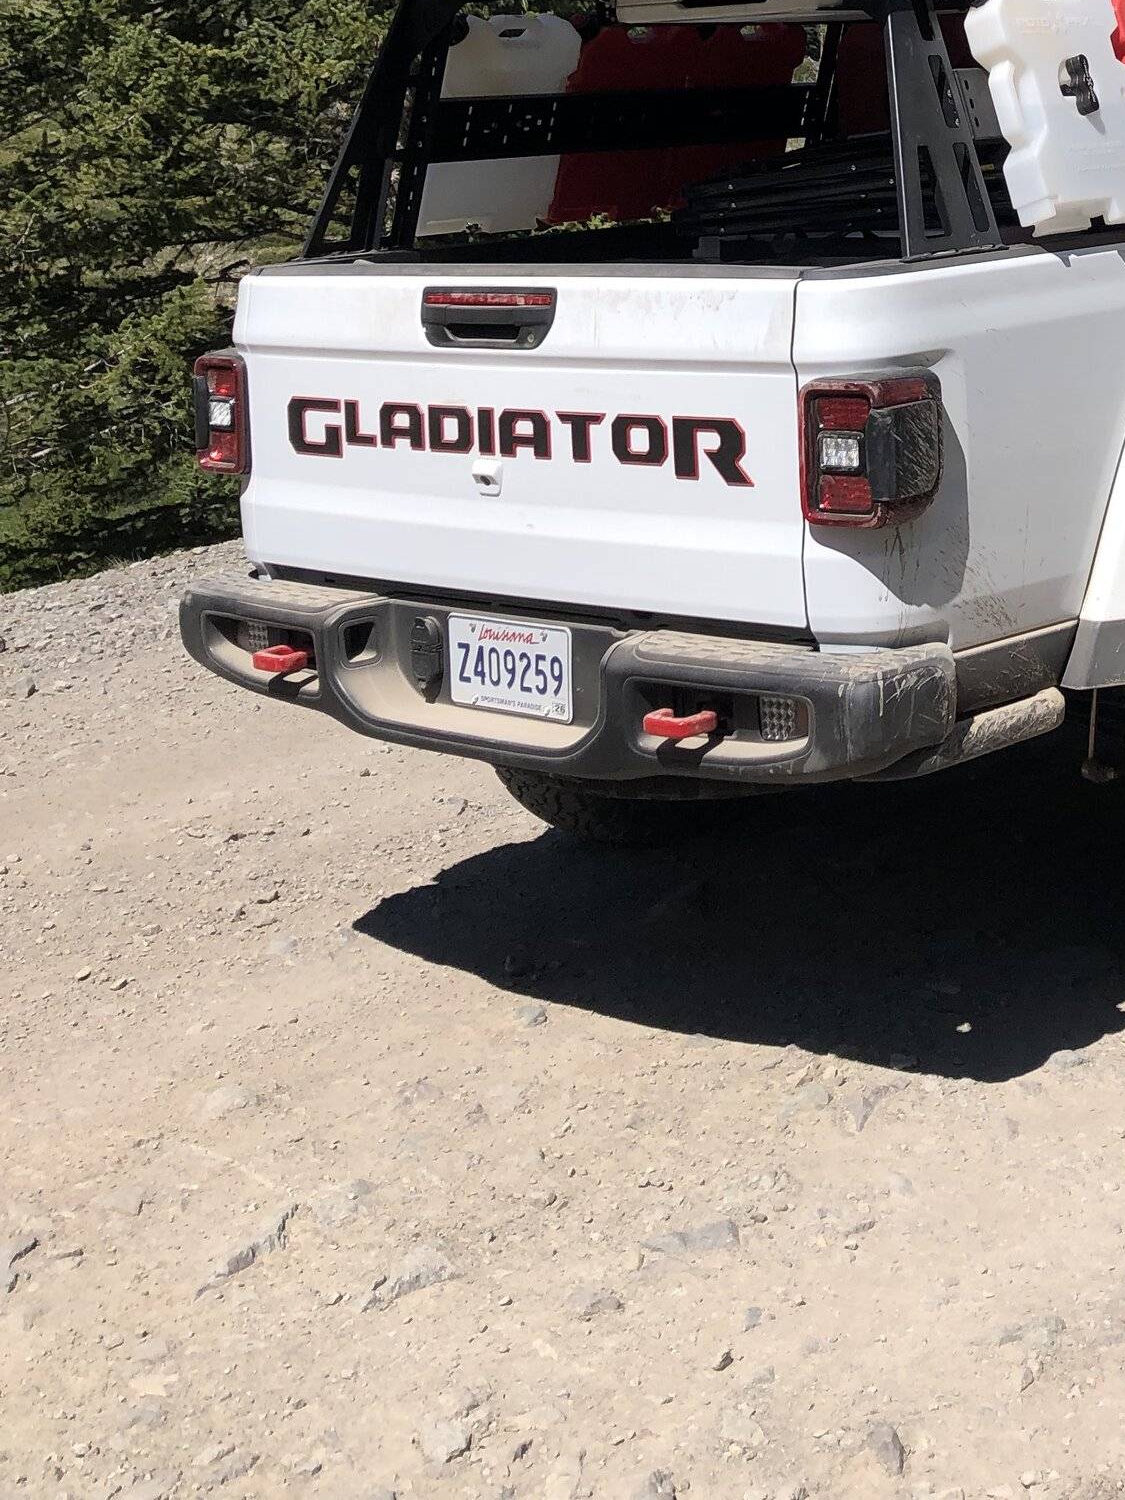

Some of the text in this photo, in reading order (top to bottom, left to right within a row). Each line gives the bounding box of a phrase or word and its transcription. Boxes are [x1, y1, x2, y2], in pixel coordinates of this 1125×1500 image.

[287, 395, 755, 488] GLADIATOR
[478, 624, 540, 645] Louisiana
[457, 642, 563, 697] Z409259
